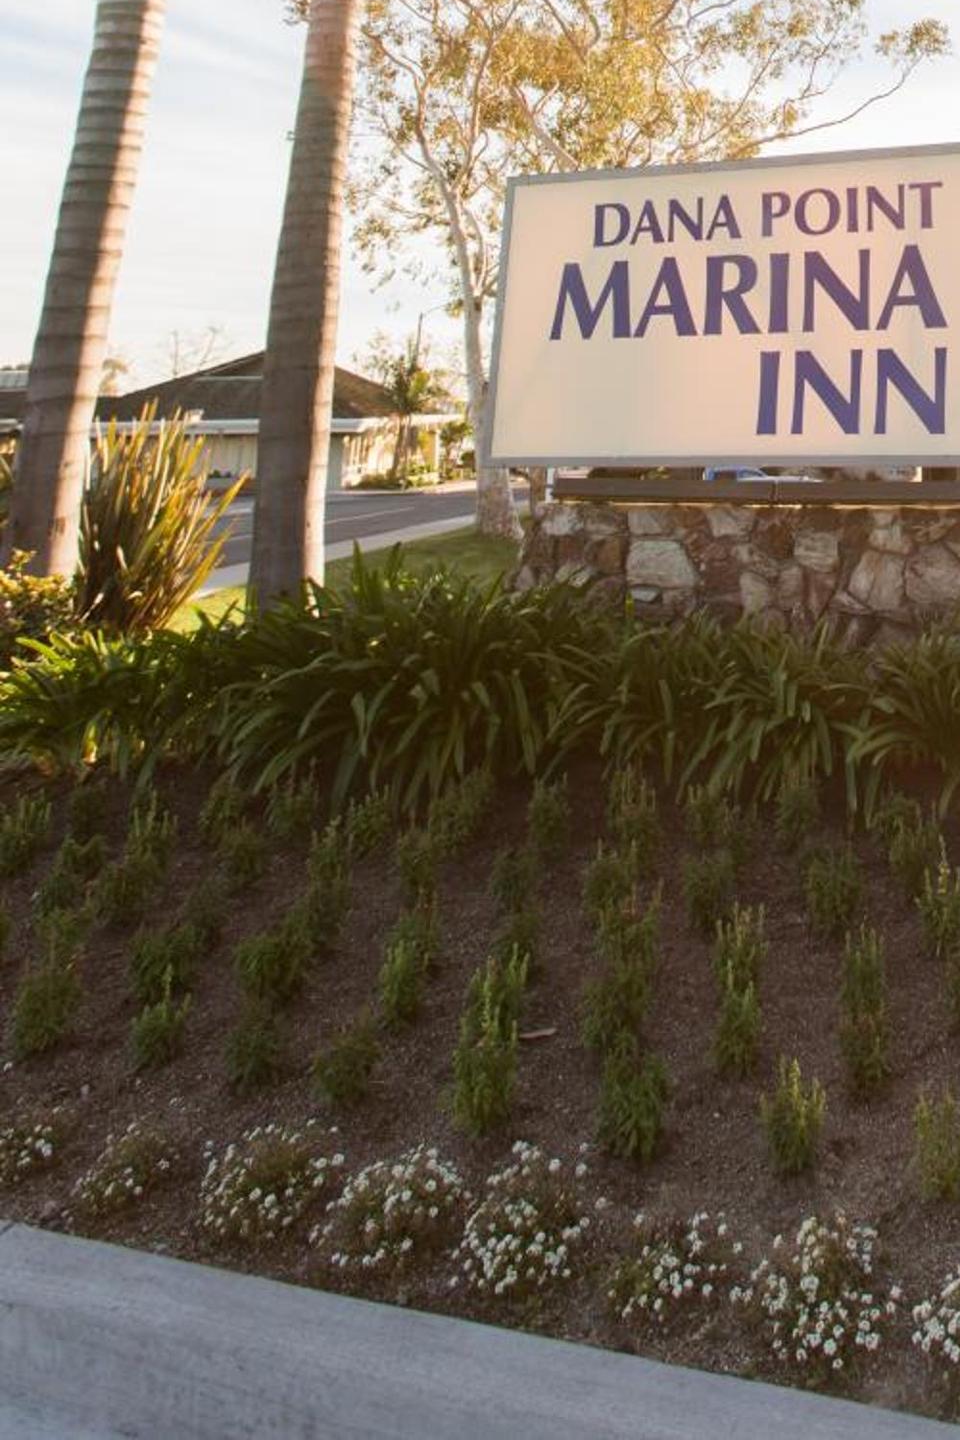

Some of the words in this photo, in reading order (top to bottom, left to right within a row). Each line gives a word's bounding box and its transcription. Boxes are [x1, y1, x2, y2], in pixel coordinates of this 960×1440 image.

[593, 194, 741, 247] DANA
[761, 181, 943, 237] POINT
[549, 244, 948, 340] MARINA
[756, 347, 948, 435] INN
